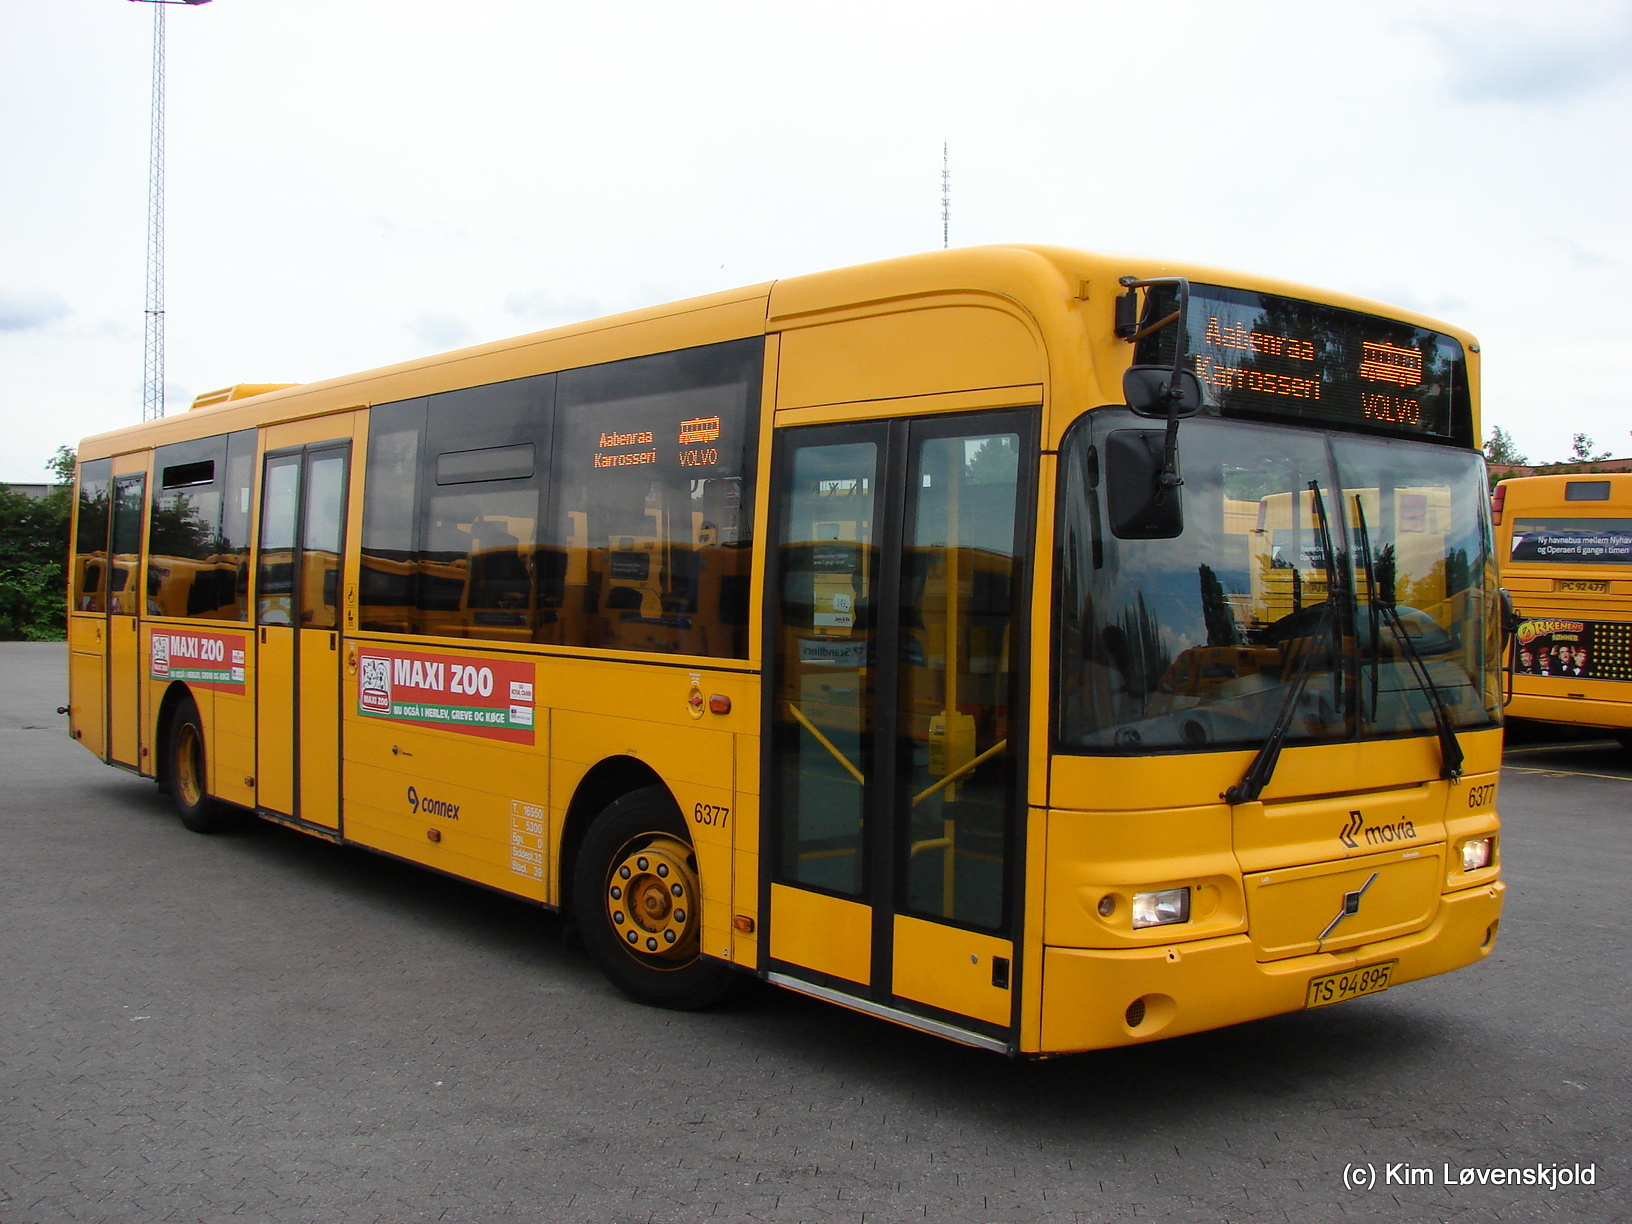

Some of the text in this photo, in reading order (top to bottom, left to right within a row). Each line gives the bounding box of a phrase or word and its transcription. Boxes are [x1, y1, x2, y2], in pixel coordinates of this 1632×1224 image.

[1206, 316, 1314, 361] Aabenraa
[1196, 354, 1320, 400] Karrosseri
[1361, 392, 1420, 425] VOLVO
[598, 431, 653, 448] Aabenraa
[593, 447, 657, 468] Karrosseri
[679, 448, 718, 466] VOLVO
[1538, 536, 1547, 545] Ny
[1537, 547, 1546, 555] og
[1547, 546, 1576, 555] Operaen
[1582, 547, 1604, 556] gange
[1609, 546, 1630, 554] timen
[1561, 583, 1606, 592] PC 92 477
[170, 635, 224, 662] MAXI ZOO
[394, 658, 494, 697] MAXI ZOO
[364, 695, 388, 706] MAXI ZOO
[394, 706, 402, 714] NU
[404, 705, 420, 716] OGSÅ
[425, 708, 450, 720] HERLEV,
[451, 709, 473, 721] GREVE
[474, 712, 484, 721] OG
[485, 712, 505, 723] KØGE
[1468, 784, 1495, 808] 6377
[422, 797, 460, 820] connex
[512, 803, 543, 819] T. 16550
[694, 803, 729, 828] 6377
[525, 821, 543, 834] 5300
[1365, 815, 1417, 845] movia
[537, 838, 543, 848] 0
[533, 866, 542, 877] 39
[1312, 966, 1390, 1003] TS 94895
